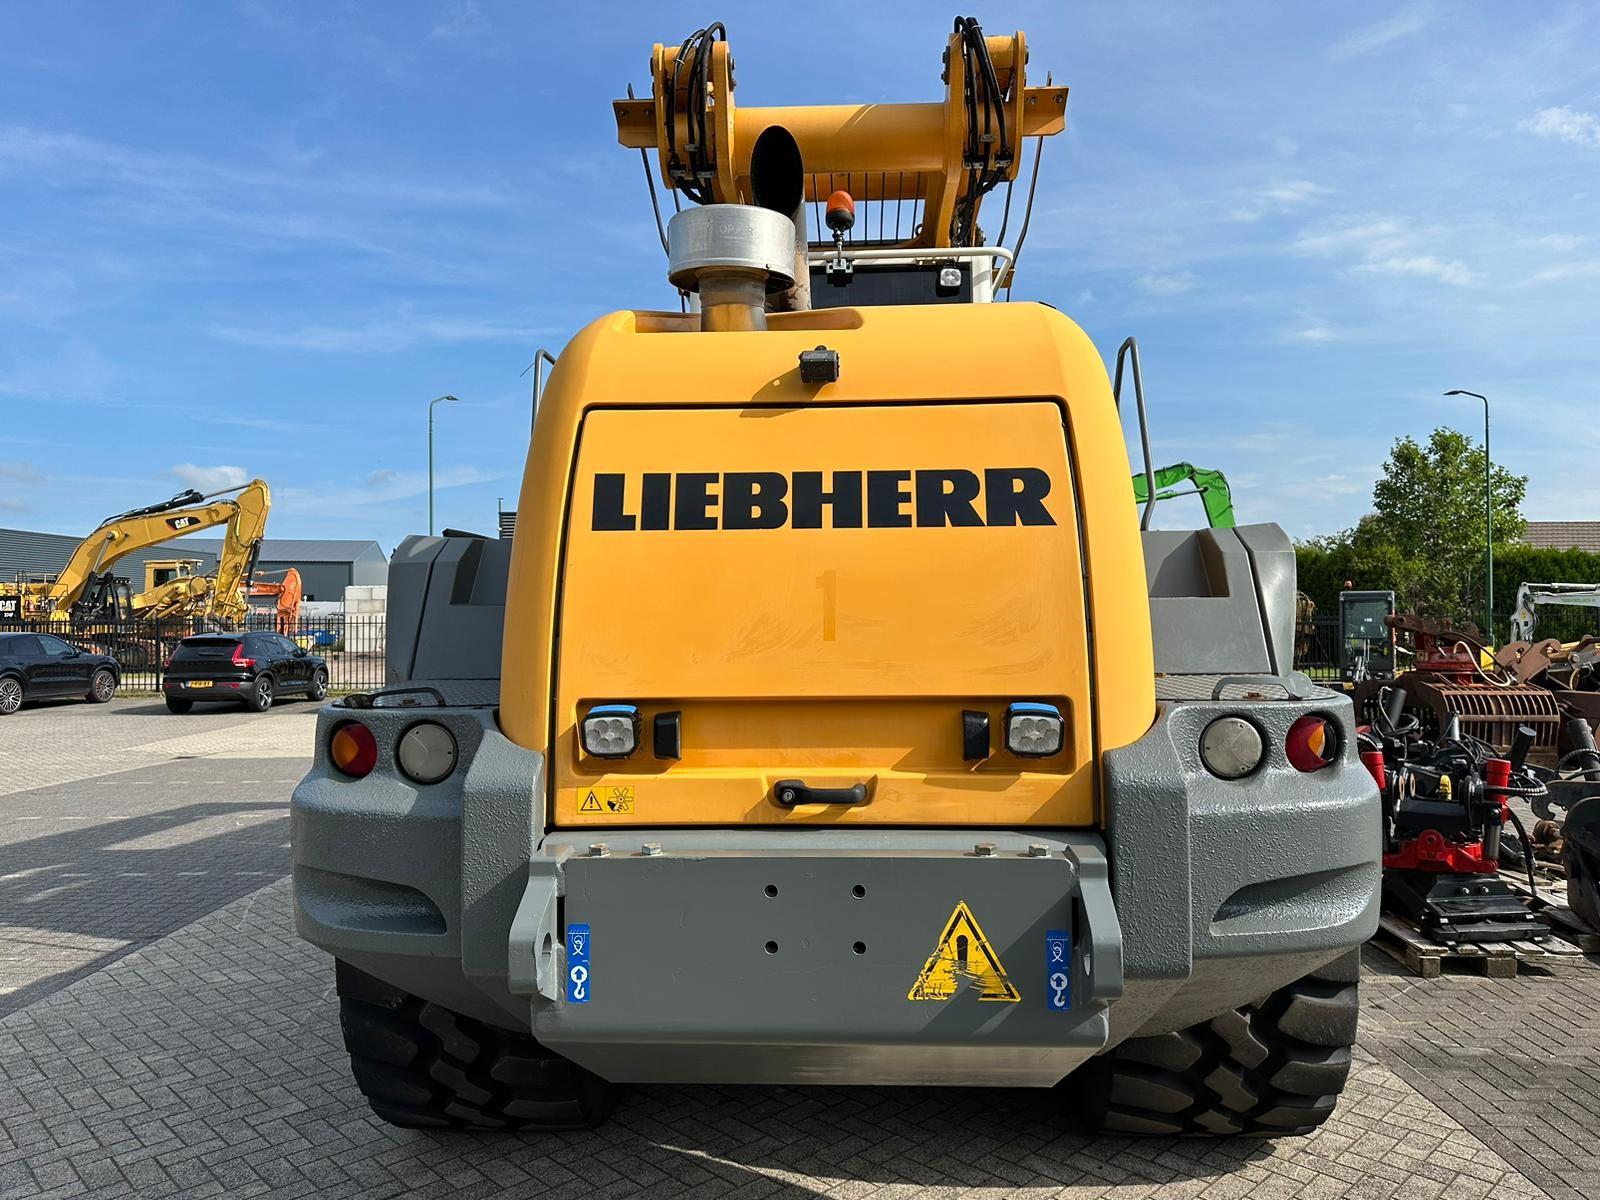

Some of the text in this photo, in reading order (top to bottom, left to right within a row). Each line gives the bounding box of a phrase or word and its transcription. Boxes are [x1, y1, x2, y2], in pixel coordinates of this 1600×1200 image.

[591, 467, 1057, 531] LIEBHERR
[174, 517, 190, 529] CAT
[0, 600, 17, 611] CAT
[815, 570, 837, 641] 1
